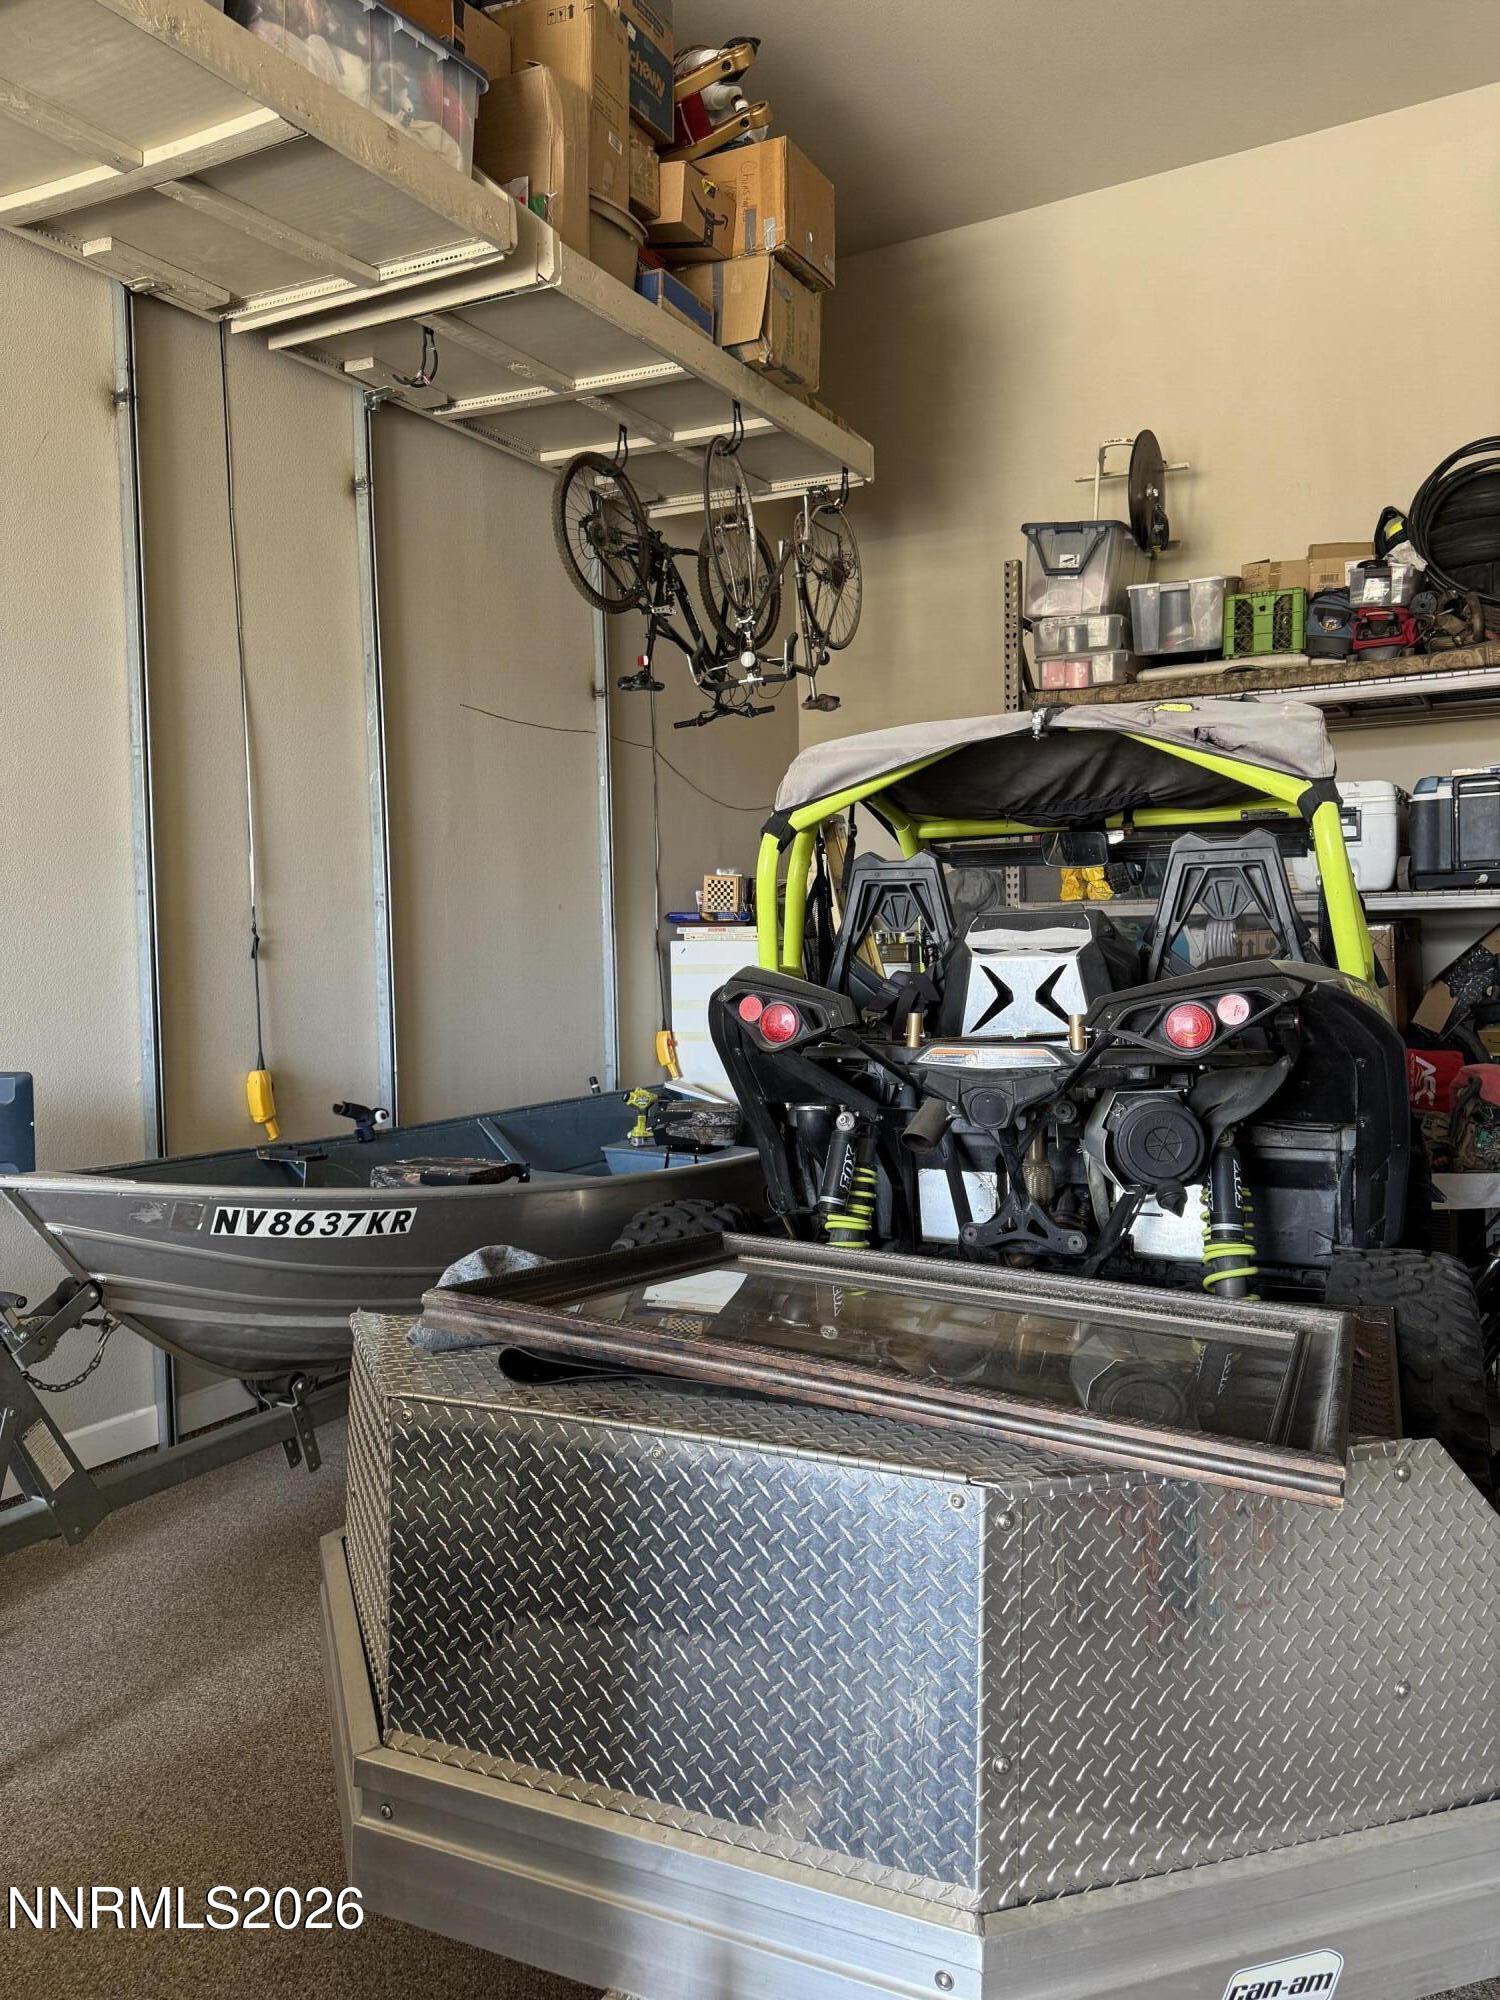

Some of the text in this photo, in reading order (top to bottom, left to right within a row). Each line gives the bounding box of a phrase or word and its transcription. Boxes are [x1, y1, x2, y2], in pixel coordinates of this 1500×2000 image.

[630, 50, 665, 98] chewy
[840, 1144, 856, 1192] FOX
[213, 1209, 412, 1237] NV8637KR
[1230, 1973, 1333, 2000] can-am
